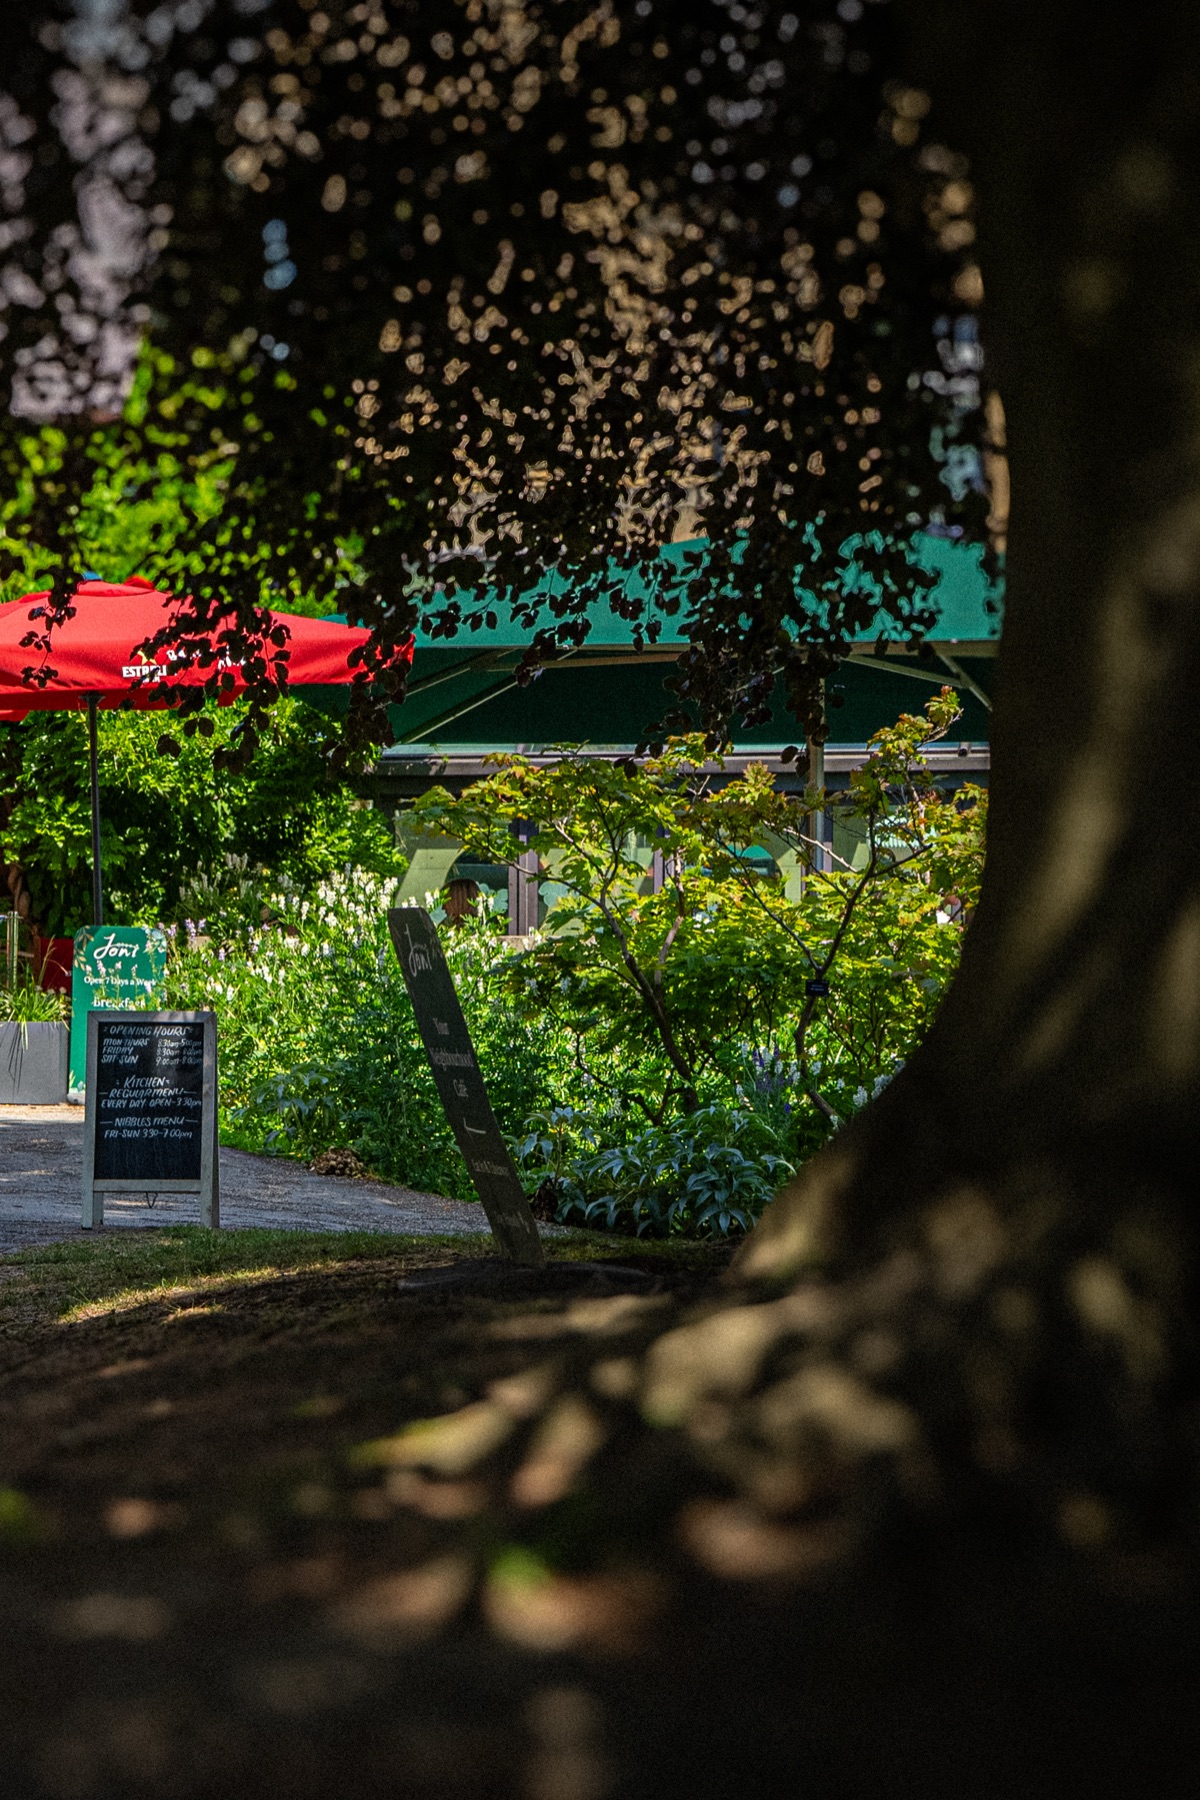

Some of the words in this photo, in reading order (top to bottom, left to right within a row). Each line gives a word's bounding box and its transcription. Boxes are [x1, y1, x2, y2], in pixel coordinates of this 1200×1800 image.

[93, 932, 140, 959] Joni
[404, 923, 433, 978] Joni
[109, 1026, 152, 1036] OPENING
[153, 1026, 189, 1037] HOURS
[101, 1046, 134, 1056] FRIDAY
[123, 1075, 166, 1089] KITCHEN
[109, 1088, 152, 1099] REGULAR
[152, 1088, 184, 1098] MENU
[101, 1099, 127, 1109] EVERY
[114, 1116, 152, 1127] NIBBLES
[152, 1116, 185, 1126] MENU
